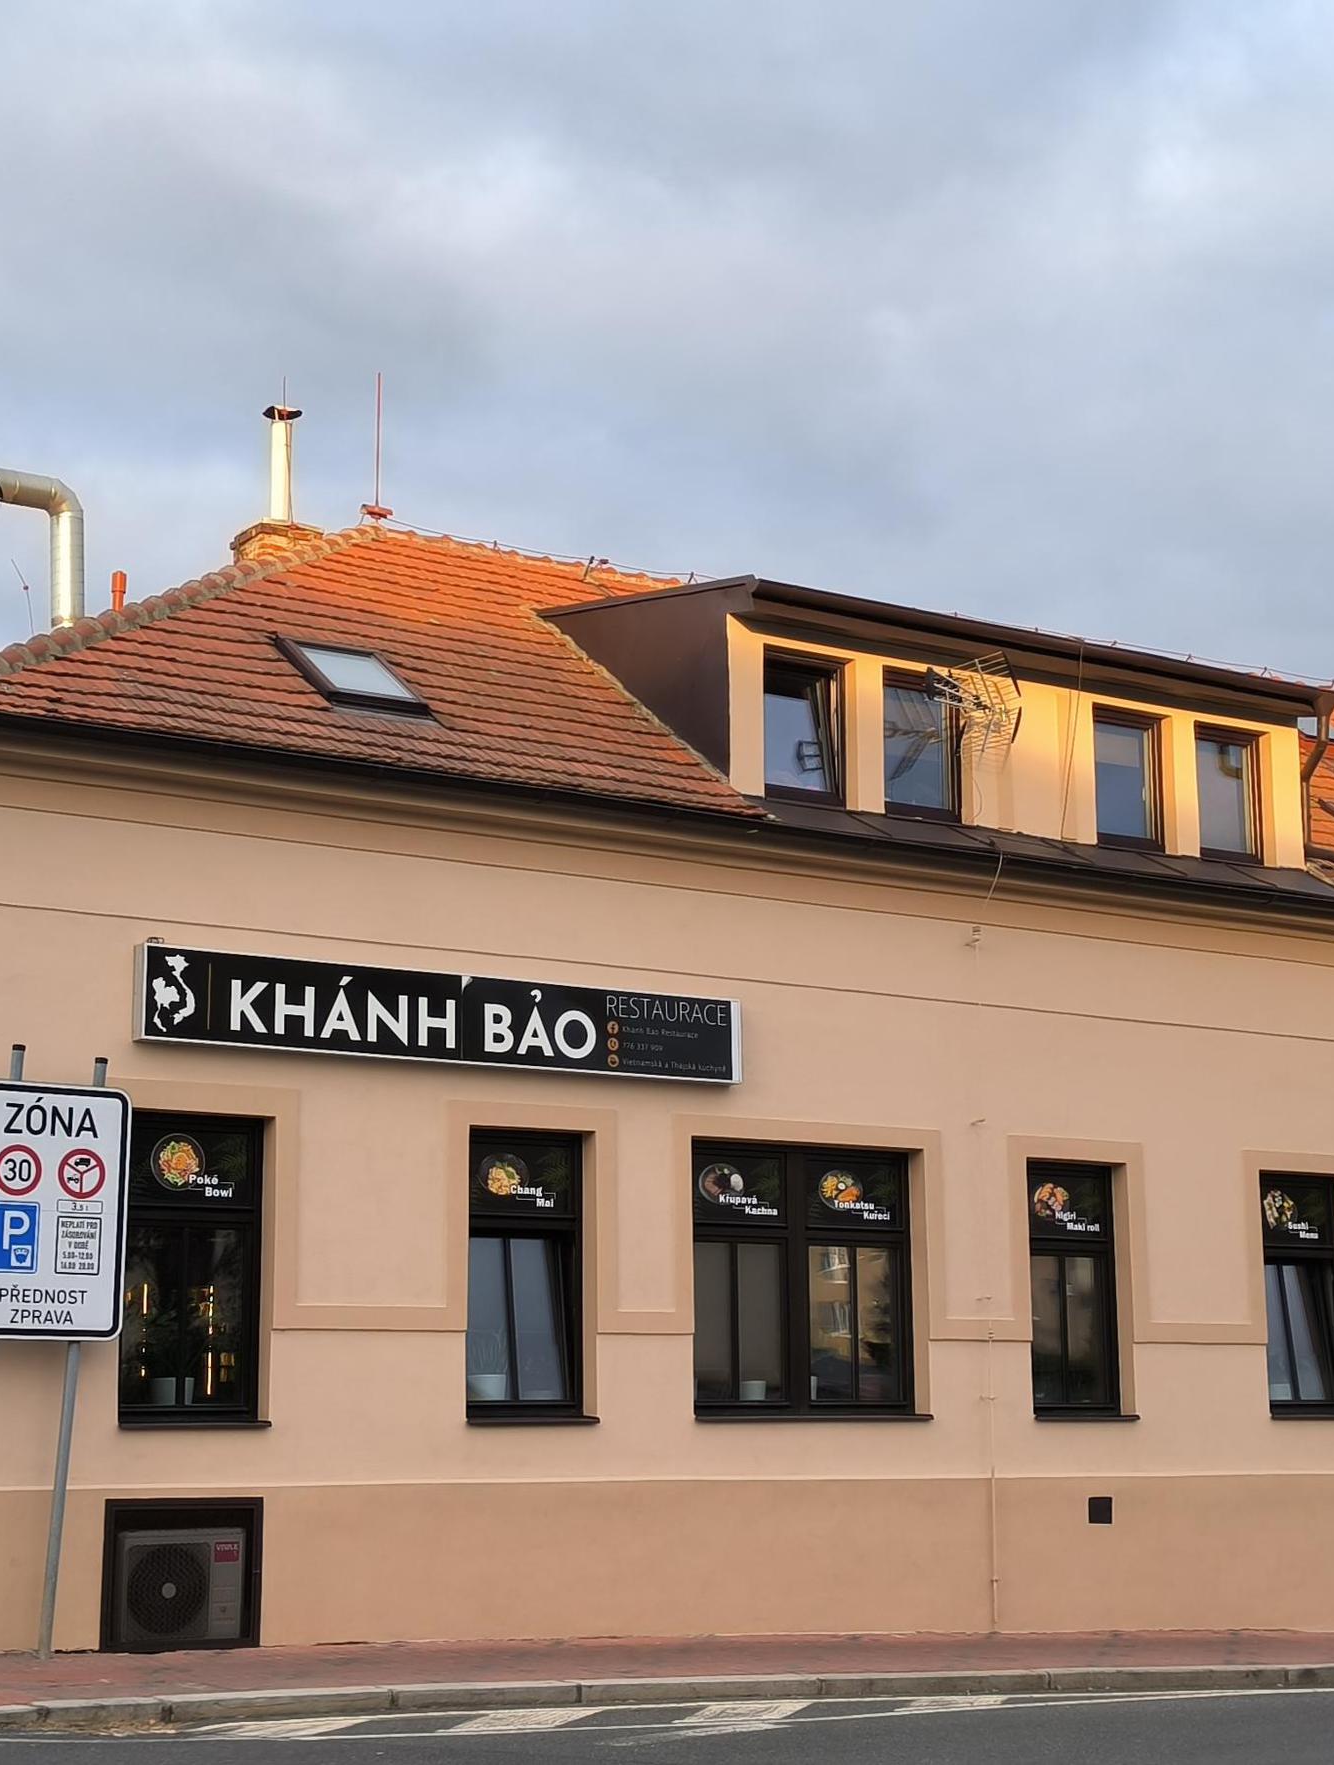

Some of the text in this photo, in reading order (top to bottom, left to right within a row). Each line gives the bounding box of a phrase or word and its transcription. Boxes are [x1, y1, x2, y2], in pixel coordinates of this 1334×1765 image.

[606, 994, 727, 1027] RESTAURACE
[230, 975, 598, 1060] KHÁNH BẢO
[3, 1097, 99, 1139] ZÓNA
[3, 1157, 32, 1183] 30
[204, 1186, 233, 1198] Bowl
[510, 1184, 543, 1197] Chang
[718, 1193, 758, 1205] Křupavá
[834, 1200, 875, 1210] Tonkatsu
[745, 1205, 779, 1216] Kachna
[1055, 1211, 1077, 1221] Nigiri
[2, 1209, 32, 1250] P
[86, 1221, 98, 1230] PRO
[1066, 1222, 1100, 1232] Maki roll
[1287, 1221, 1309, 1230] Sushi
[9, 1308, 74, 1326] ZPRAVA
